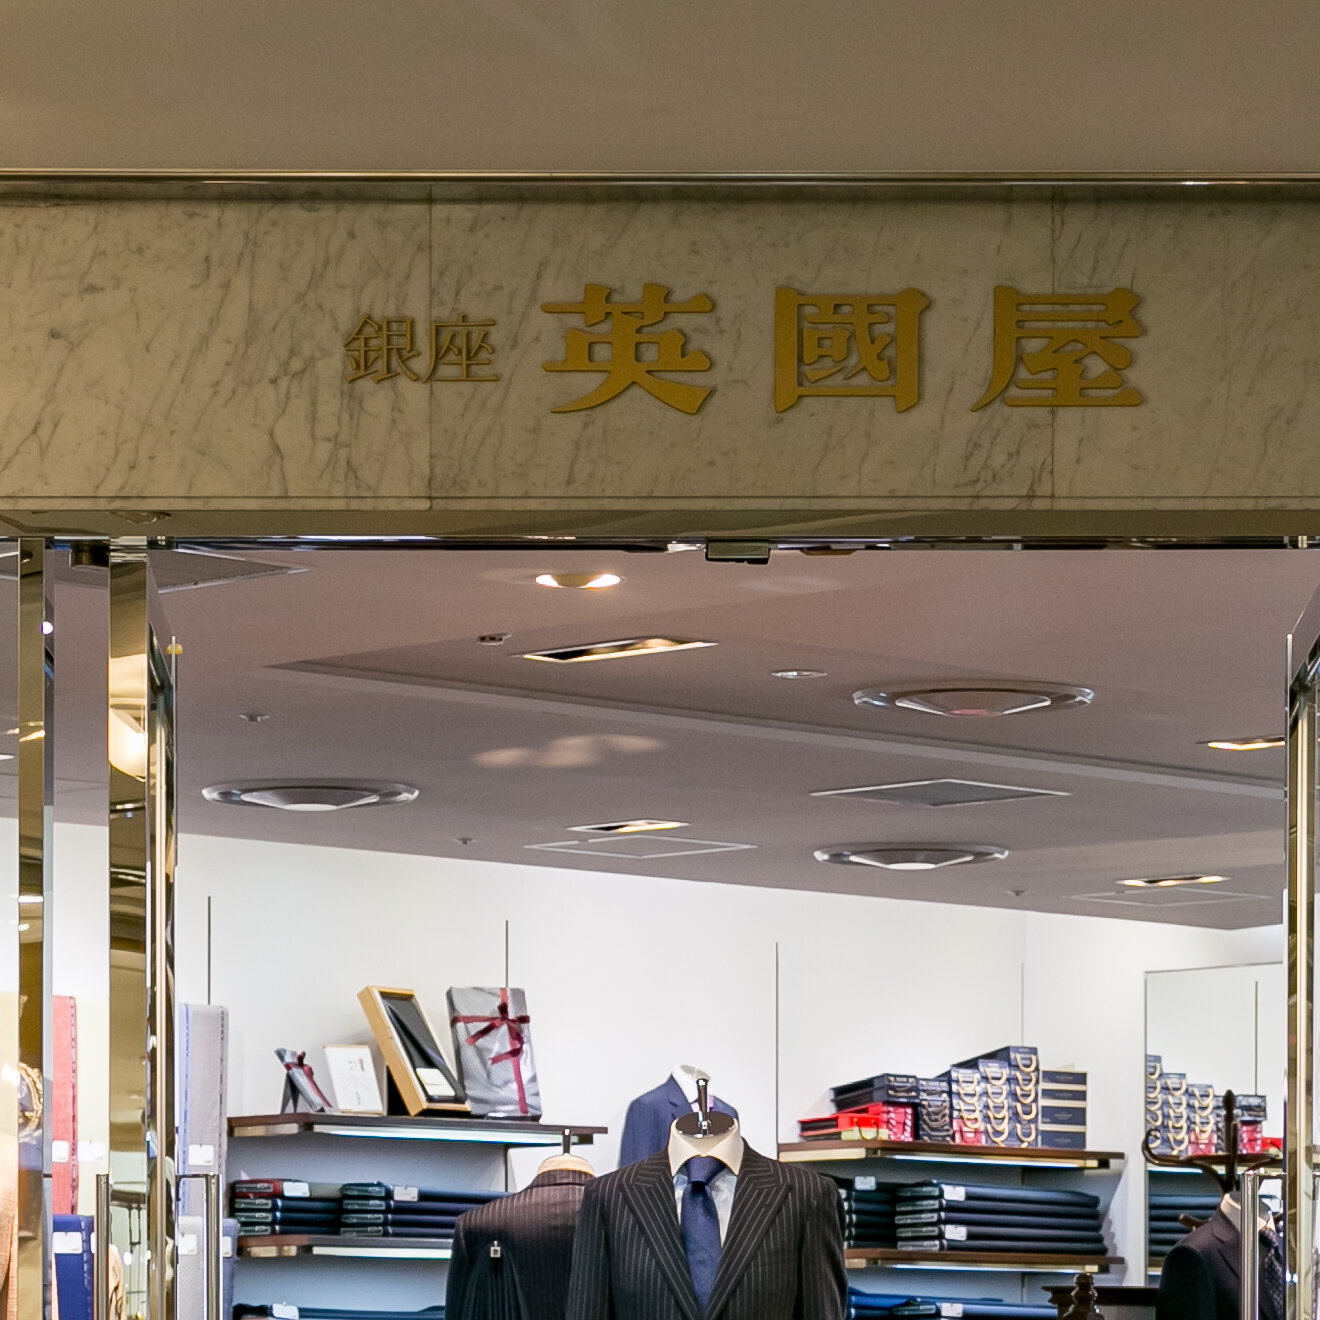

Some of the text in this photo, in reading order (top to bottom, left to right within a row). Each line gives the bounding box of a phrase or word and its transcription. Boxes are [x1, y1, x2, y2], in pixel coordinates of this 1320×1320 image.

[342, 282, 1145, 416] 銀座 英國屋
